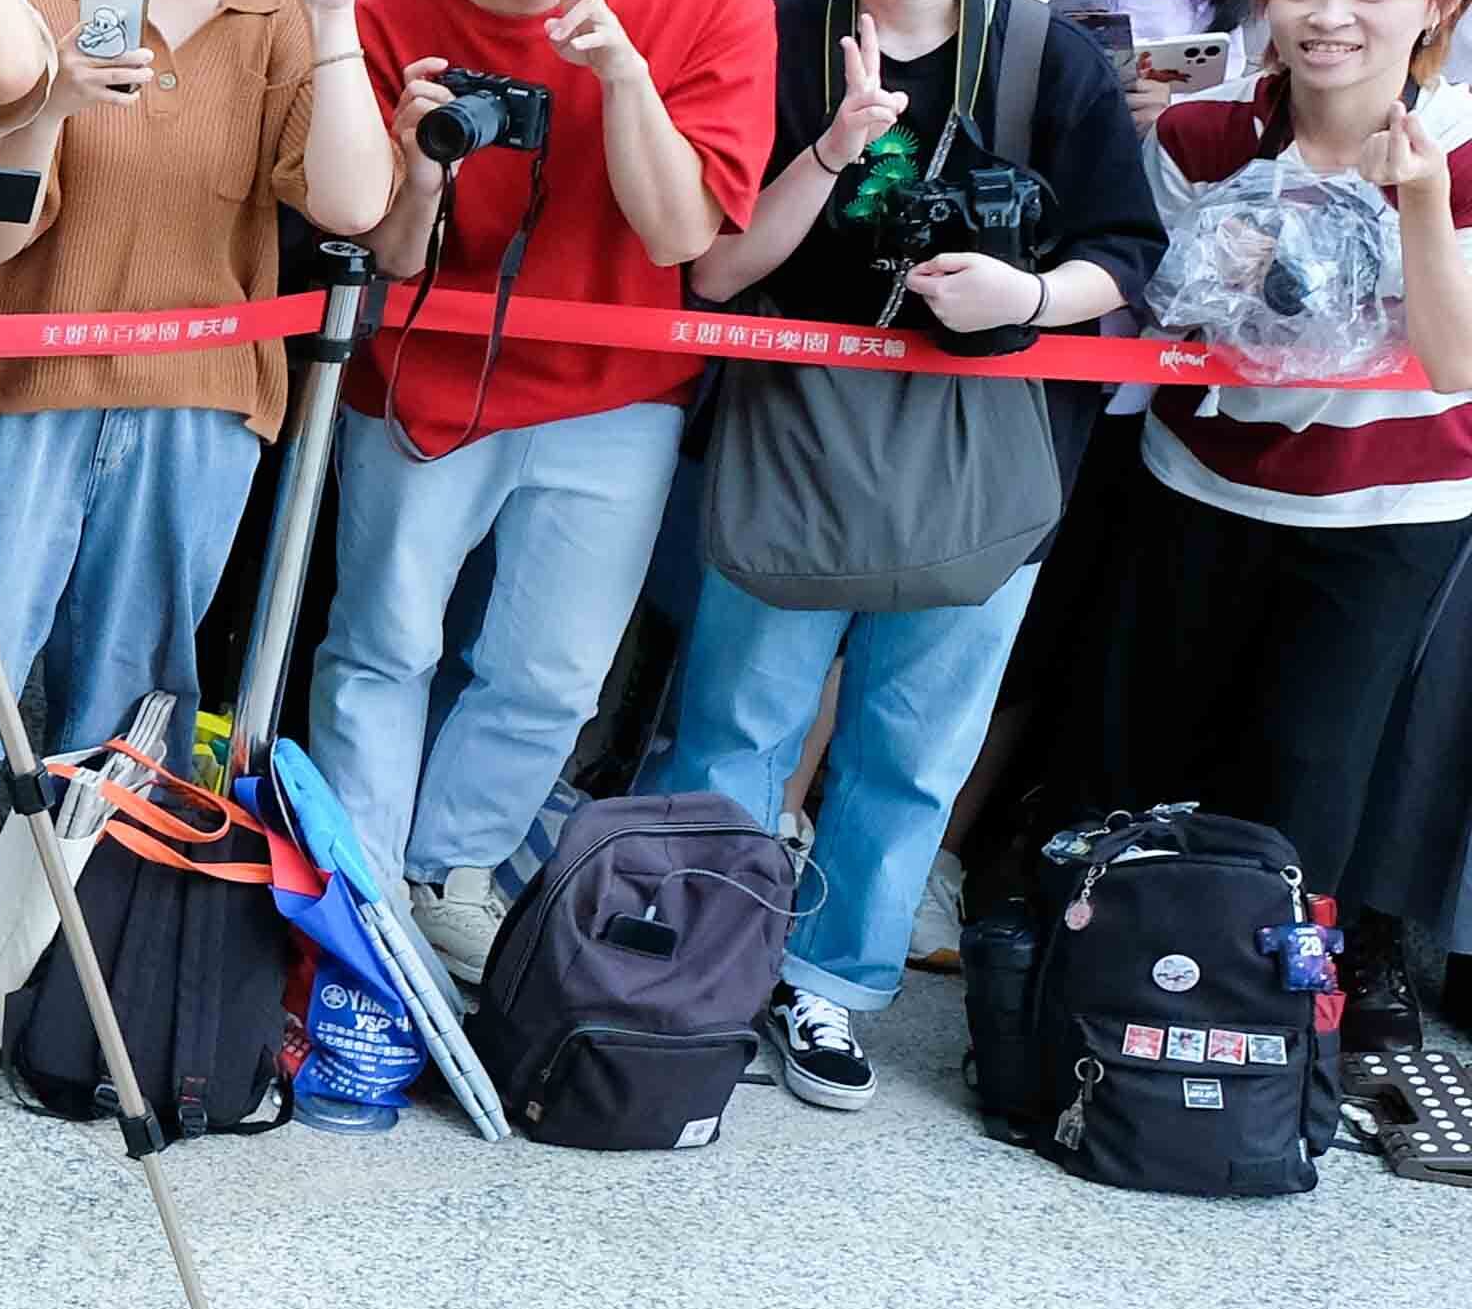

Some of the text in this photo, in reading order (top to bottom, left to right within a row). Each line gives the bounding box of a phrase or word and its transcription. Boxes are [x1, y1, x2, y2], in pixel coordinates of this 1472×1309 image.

[41, 316, 238, 346] 美麗華百樂園 摩天輪
[671, 322, 906, 359] 美麗華百樂園 摩天輪
